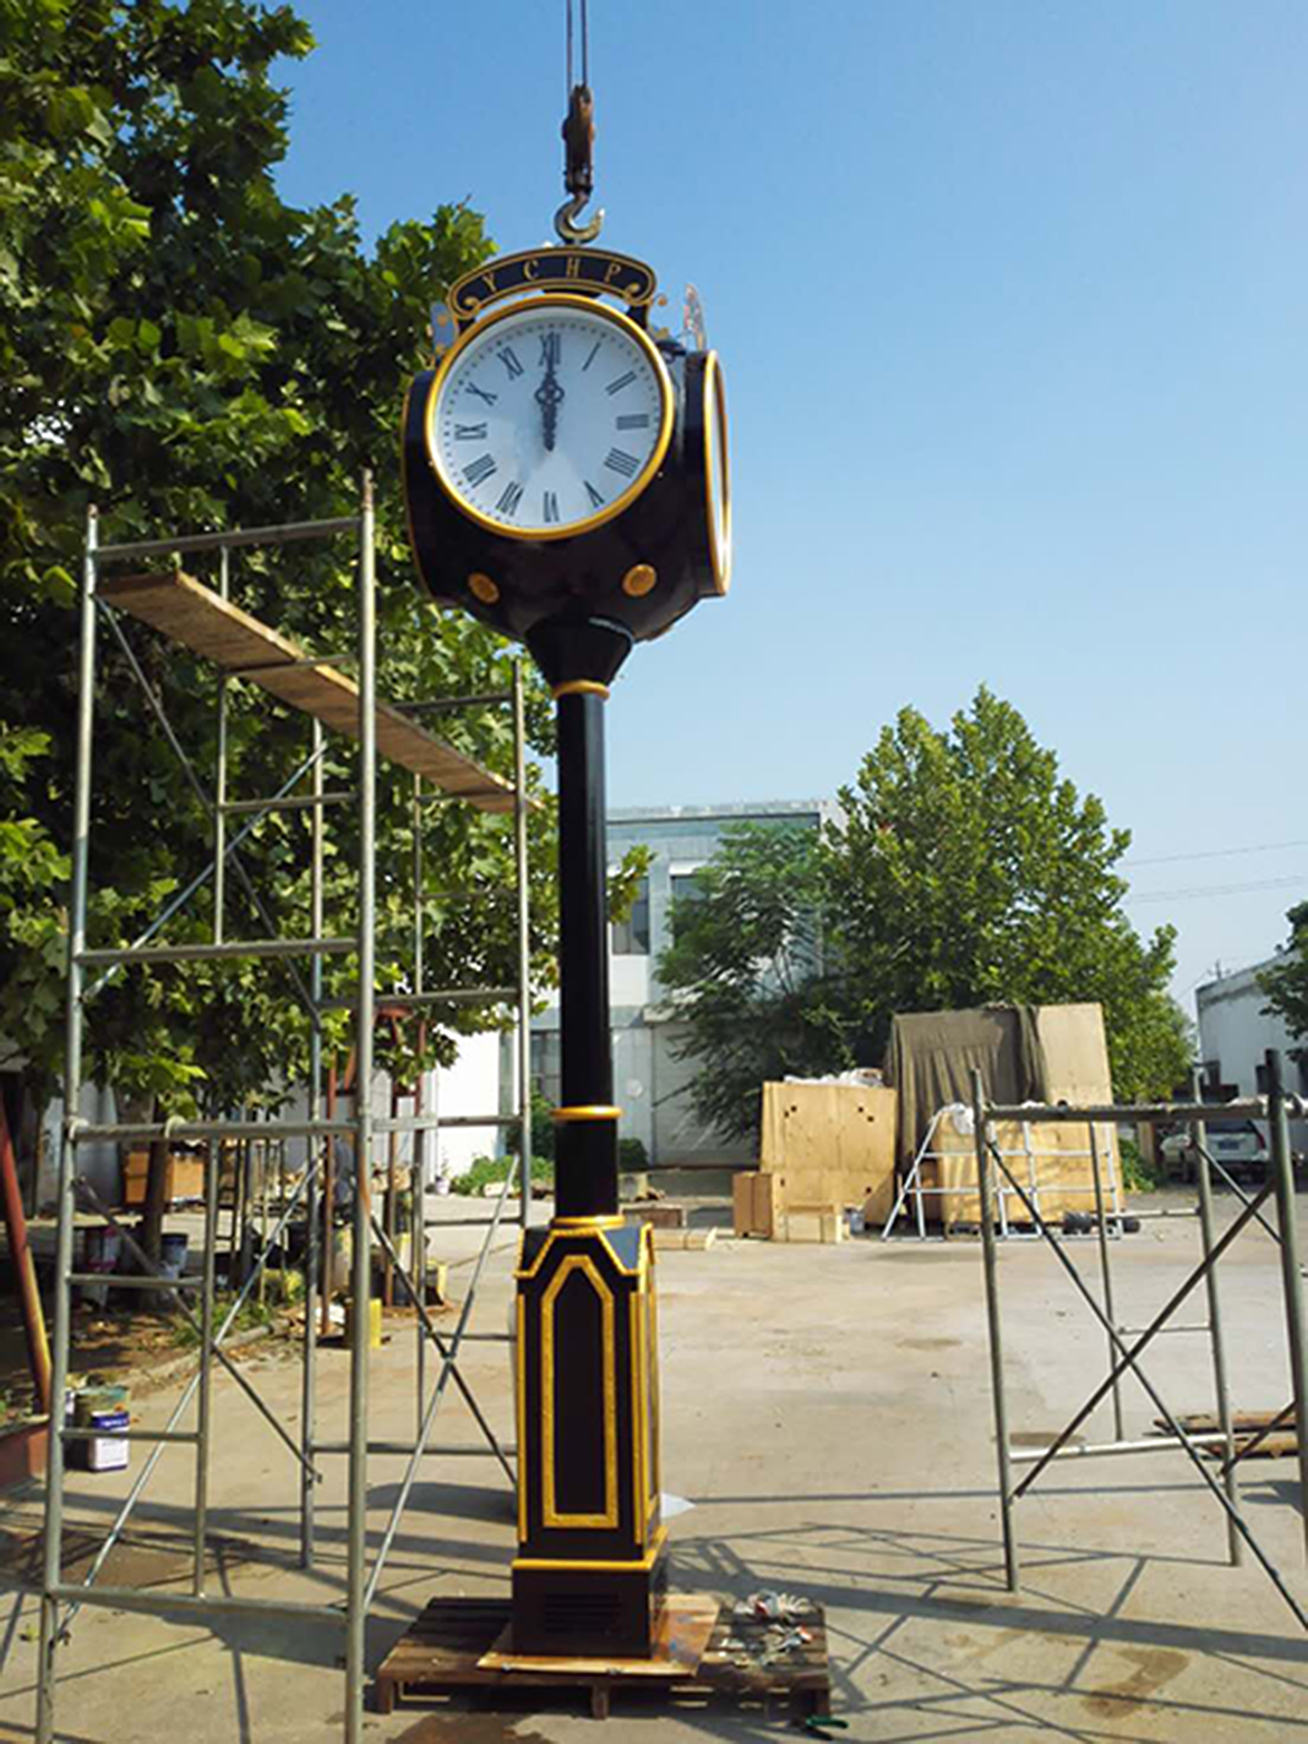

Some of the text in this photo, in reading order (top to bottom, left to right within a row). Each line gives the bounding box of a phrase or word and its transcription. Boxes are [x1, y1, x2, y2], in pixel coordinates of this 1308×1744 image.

[496, 345, 525, 381] XI
[582, 341, 602, 372] I
[465, 381, 498, 406] X
[605, 371, 637, 396] II
[454, 422, 488, 440] IX
[616, 414, 649, 431] III
[461, 453, 498, 489] VIII
[603, 447, 641, 479] IIII
[495, 481, 524, 517] VII
[543, 490, 560, 523] VI
[583, 479, 606, 508] V
